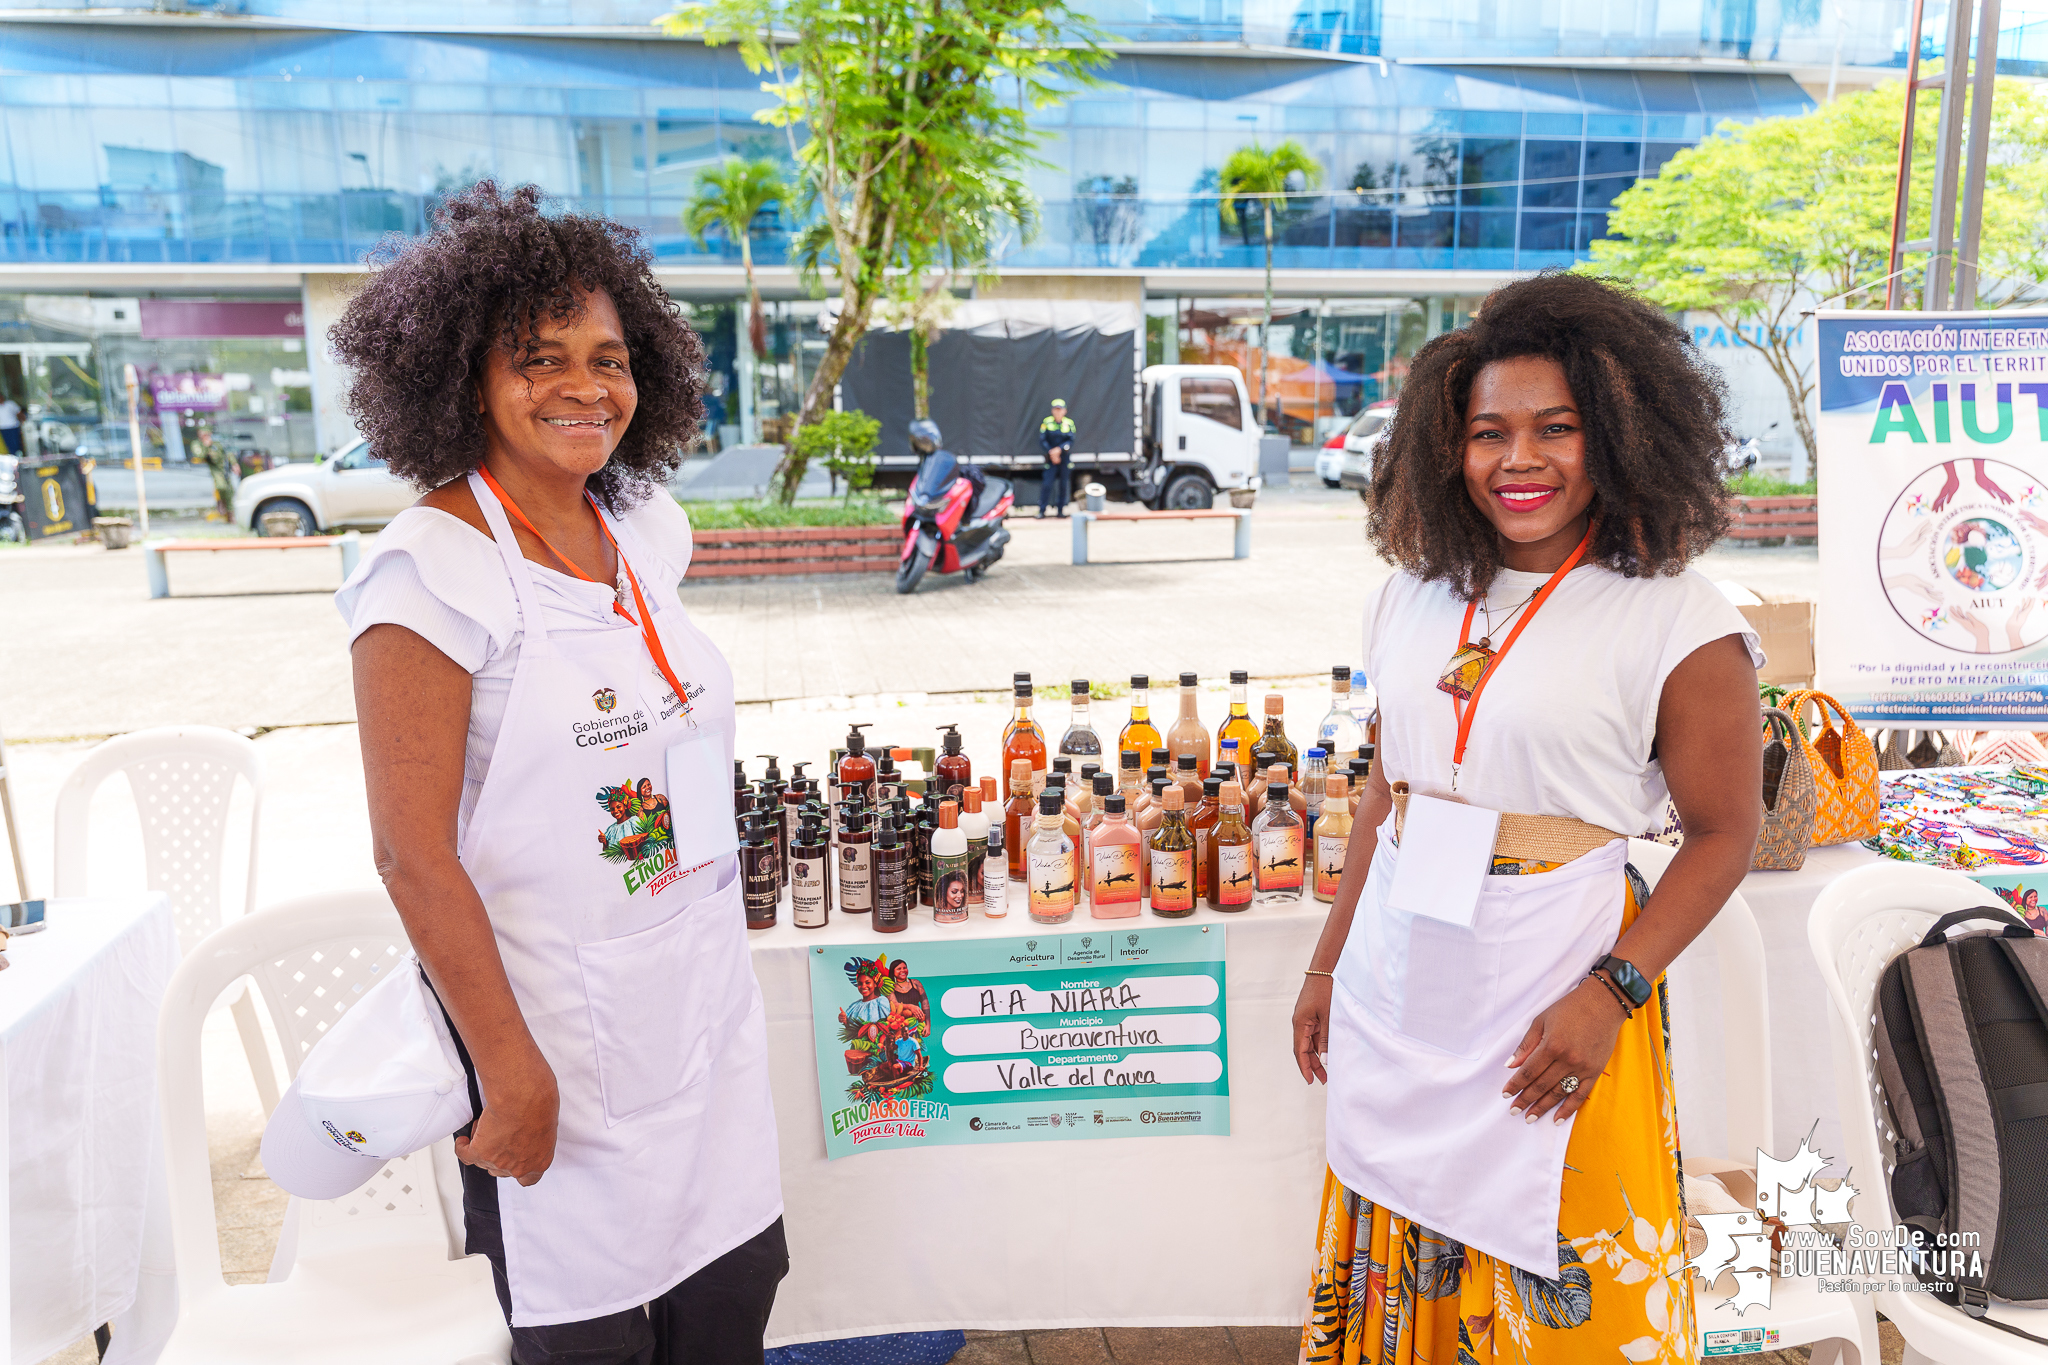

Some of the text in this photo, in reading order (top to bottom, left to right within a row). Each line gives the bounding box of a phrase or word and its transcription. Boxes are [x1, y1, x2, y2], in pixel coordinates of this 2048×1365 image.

[1845, 324, 2048, 350] ASOCIACIÓN INTERETN
[1842, 356, 2047, 374] UNIDOS POR EL TERRIT
[1869, 381, 2048, 445] AIUT
[1969, 598, 2006, 609] AIUT
[1881, 663, 1891, 672] la
[1895, 662, 1945, 673] dignidad
[1949, 664, 1956, 673] y
[1960, 662, 1970, 671] la
[681, 681, 691, 691] de
[1891, 676, 1942, 685] PUERTO
[1947, 675, 2025, 686] MERIZALDE
[686, 683, 706, 701] Rural
[1870, 691, 1911, 702] Teléfono:
[1876, 704, 1930, 715] electrónico:
[572, 709, 645, 734] Gobierno de
[575, 721, 649, 748] Colombia
[650, 870, 677, 897] para
[748, 874, 770, 883] NATUR
[1009, 954, 1055, 963] Agricultura
[1120, 948, 1149, 956] Interior
[1060, 979, 1100, 990] Nombre
[1050, 984, 1141, 1013] NIARA
[1060, 1017, 1103, 1027] Municipio
[1021, 1023, 1163, 1050] Buenaventura
[1047, 1053, 1118, 1065] Departamento
[997, 1063, 1161, 1089] Valle del Cauca
[831, 1099, 950, 1137] ETNOAGROFERIA
[853, 1122, 927, 1145] para la Vida
